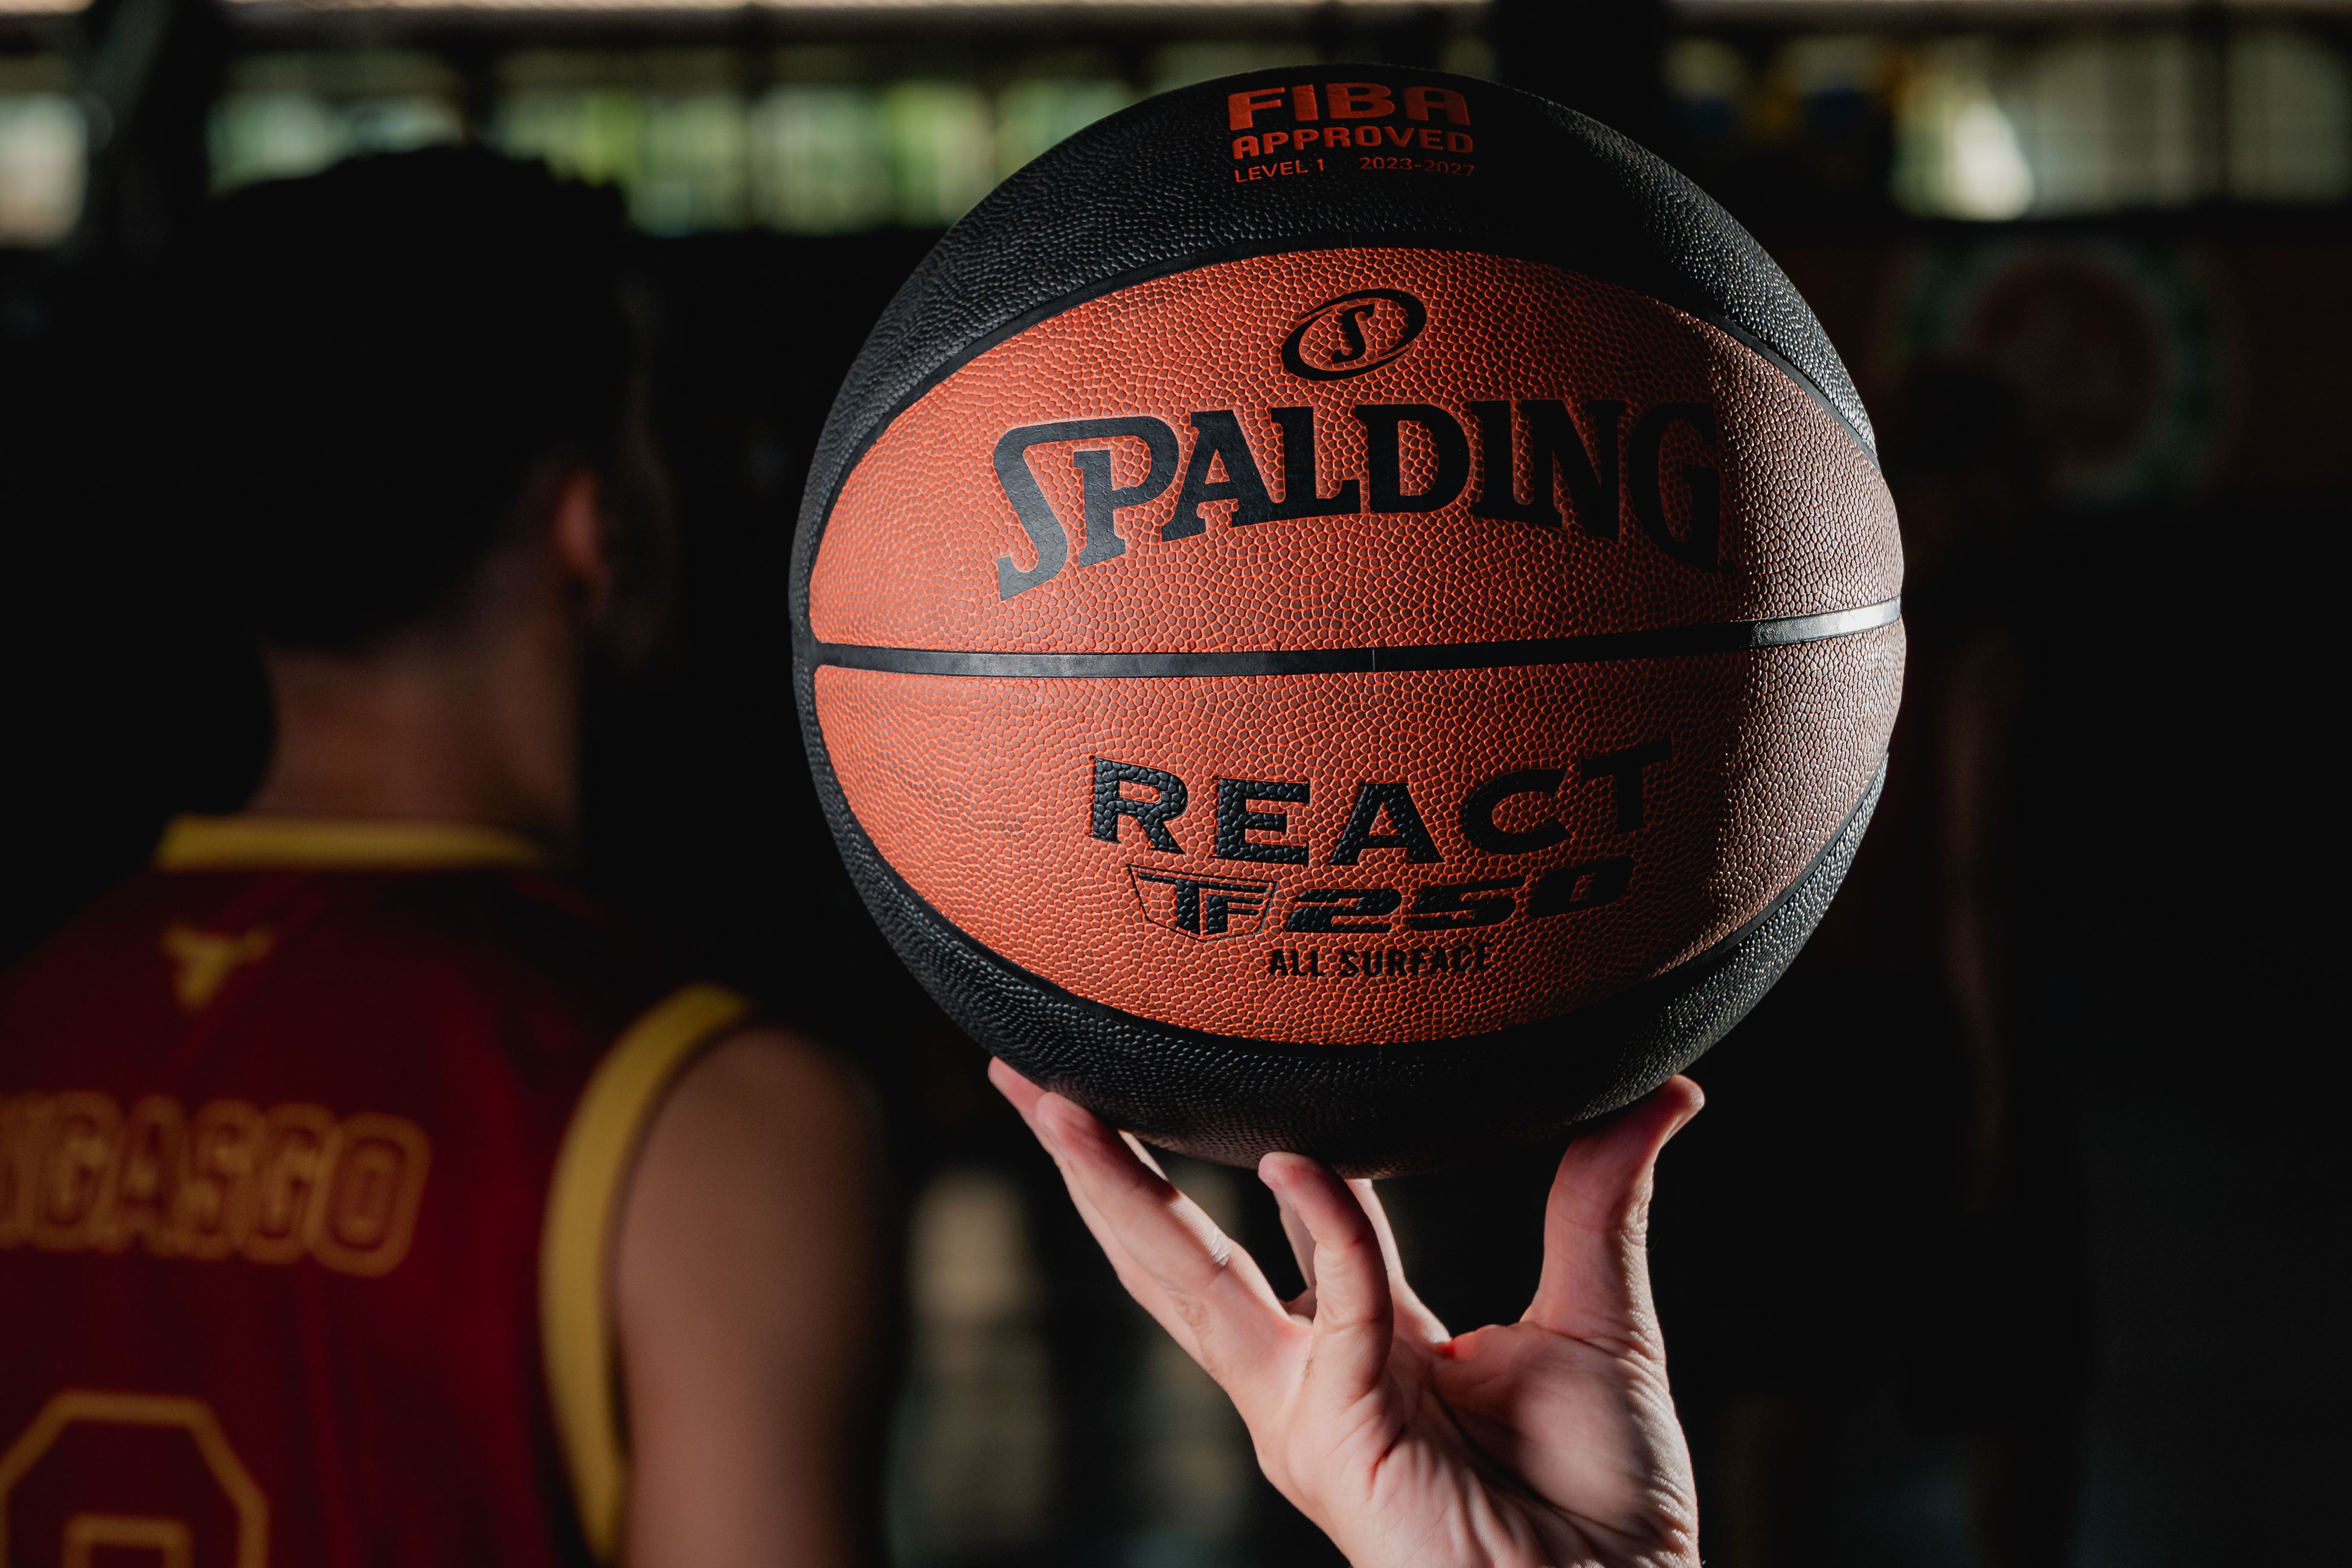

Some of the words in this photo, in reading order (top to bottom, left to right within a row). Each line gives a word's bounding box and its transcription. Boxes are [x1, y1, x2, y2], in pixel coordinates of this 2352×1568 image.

[1227, 82, 1471, 131] FIBA
[1231, 124, 1474, 160] APPROVED
[1234, 159, 1309, 184] LEVEL
[1316, 158, 1325, 172] 1
[1358, 156, 1477, 178] 2023-2027
[992, 398, 1724, 601] SPALDING
[1091, 739, 1673, 868] REACT
[1267, 947, 1327, 977] ALL
[1341, 941, 1493, 977] SURFACE
